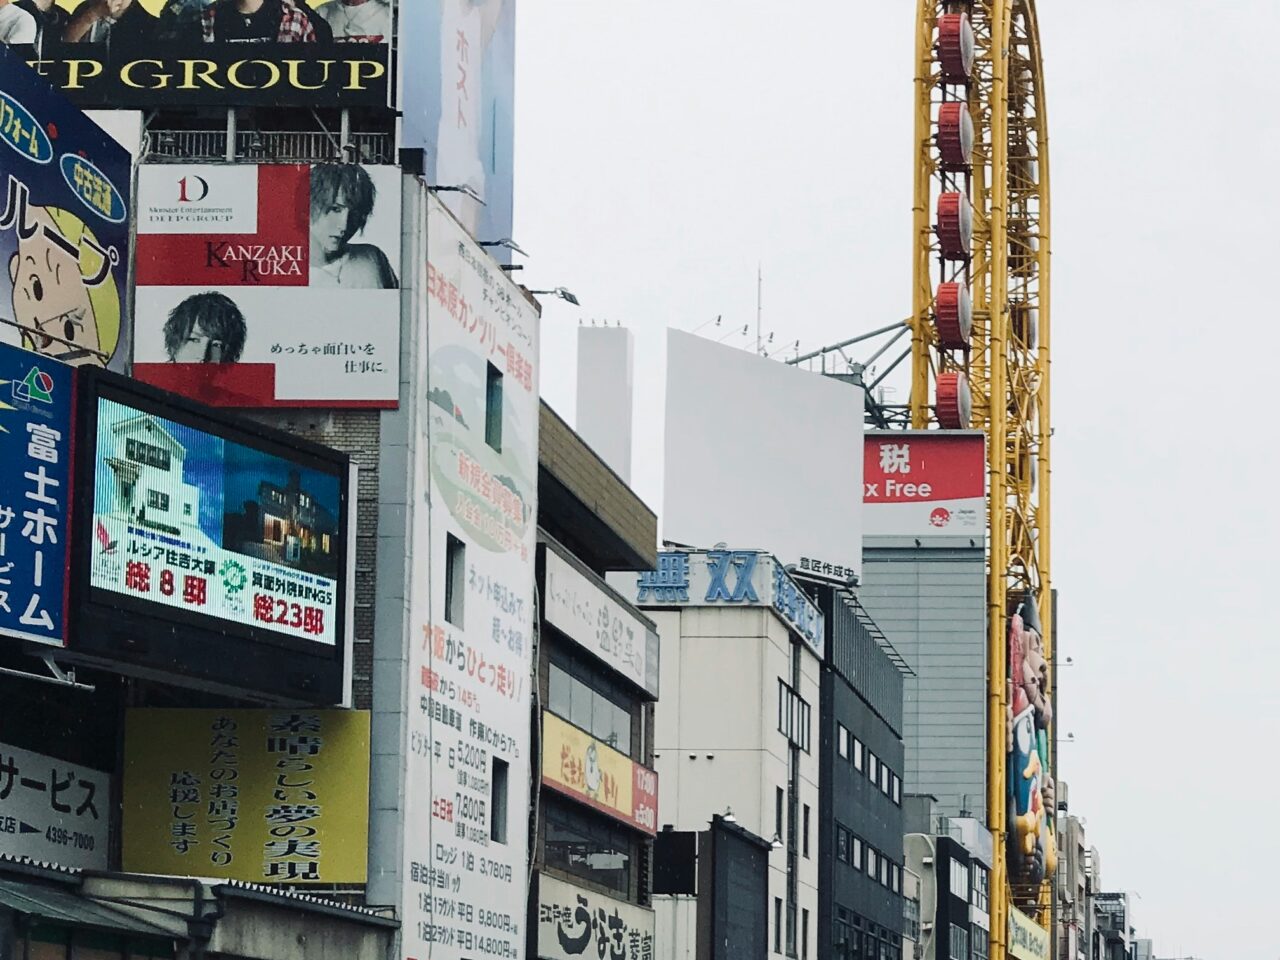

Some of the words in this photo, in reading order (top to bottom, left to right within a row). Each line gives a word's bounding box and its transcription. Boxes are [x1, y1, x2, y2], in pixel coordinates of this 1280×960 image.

[120, 59, 385, 90] GROUP
[205, 241, 303, 267] KANZAKI
[241, 259, 303, 282] RUKA
[270, 343, 376, 356] めっちゃ面白いを
[344, 359, 389, 374] 仕事に。
[879, 444, 911, 474] 税
[885, 479, 932, 498] Free
[19, 421, 62, 631] 富士ホーム
[457, 739, 487, 774] 5,200円
[208, 715, 240, 867] あなたのお店づくり
[264, 713, 322, 881] 素晴らしい夢の実現
[168, 770, 201, 854] 応援します
[456, 791, 486, 826] 7,800円
[46, 824, 95, 851] 4396-7000
[435, 843, 457, 866] ロッジ
[480, 857, 512, 883] 3,780円
